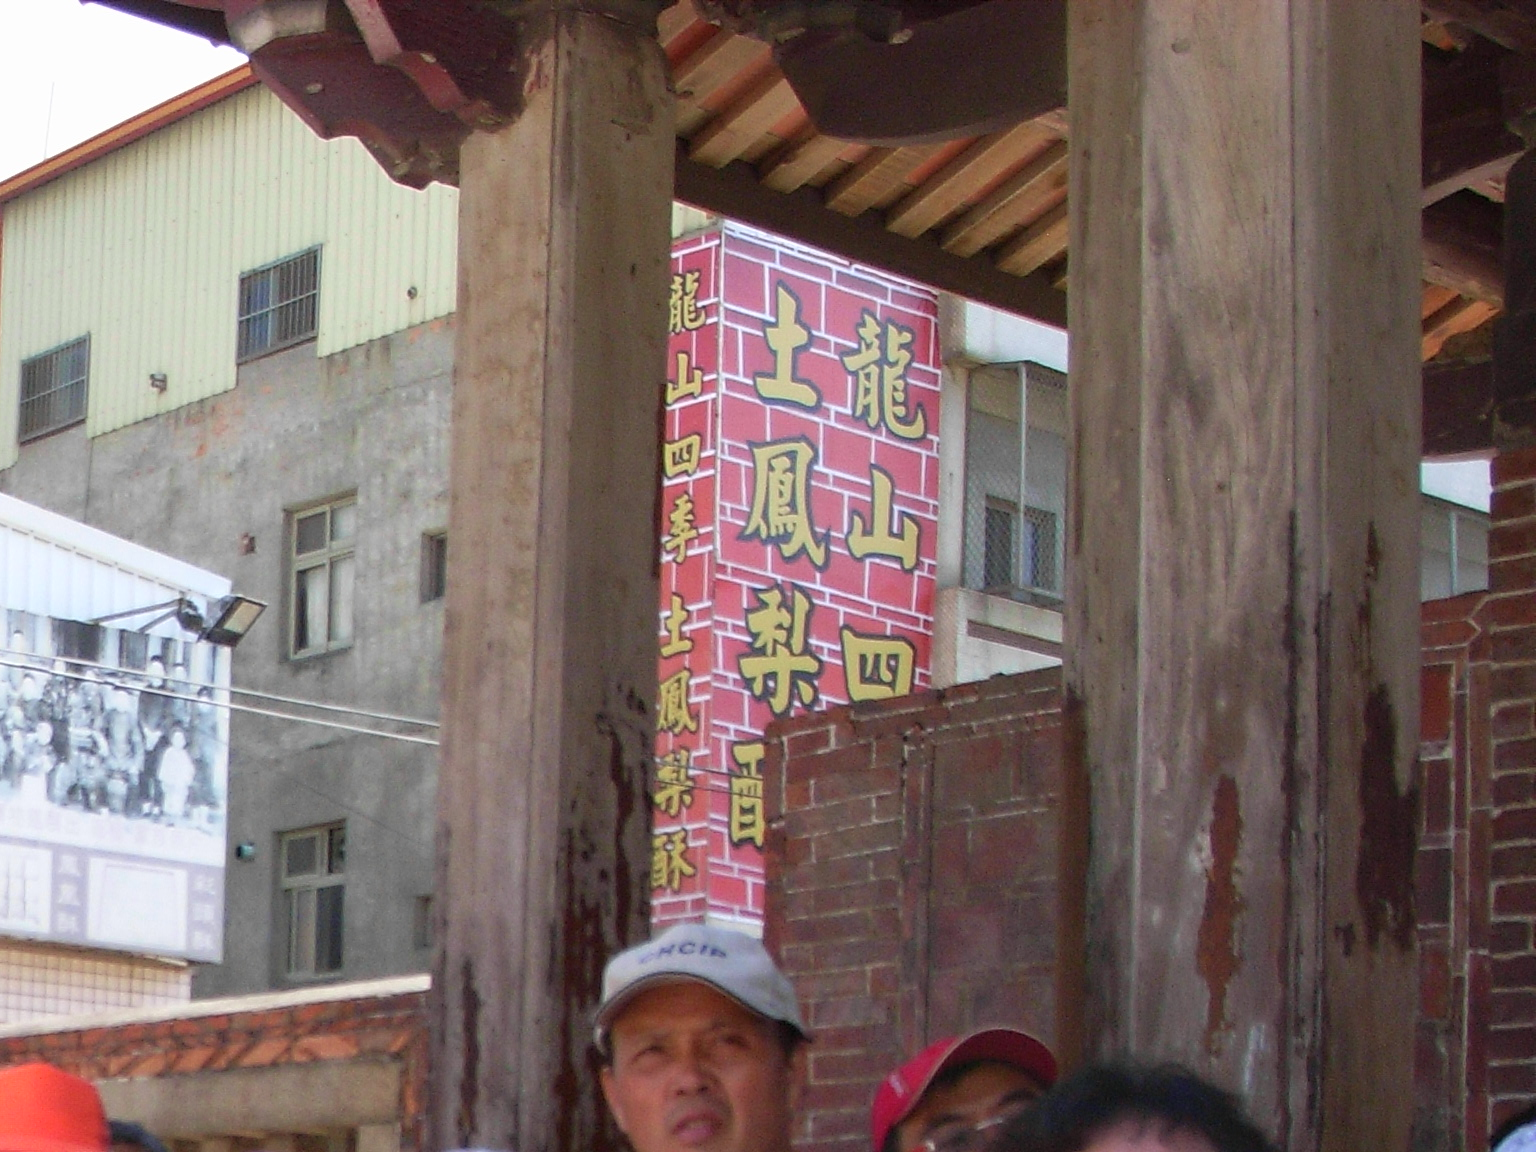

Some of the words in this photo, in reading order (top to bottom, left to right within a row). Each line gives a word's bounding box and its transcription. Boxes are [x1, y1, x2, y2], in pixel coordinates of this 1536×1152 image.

[651, 271, 707, 894] 龍山四季土鳳梨酥
